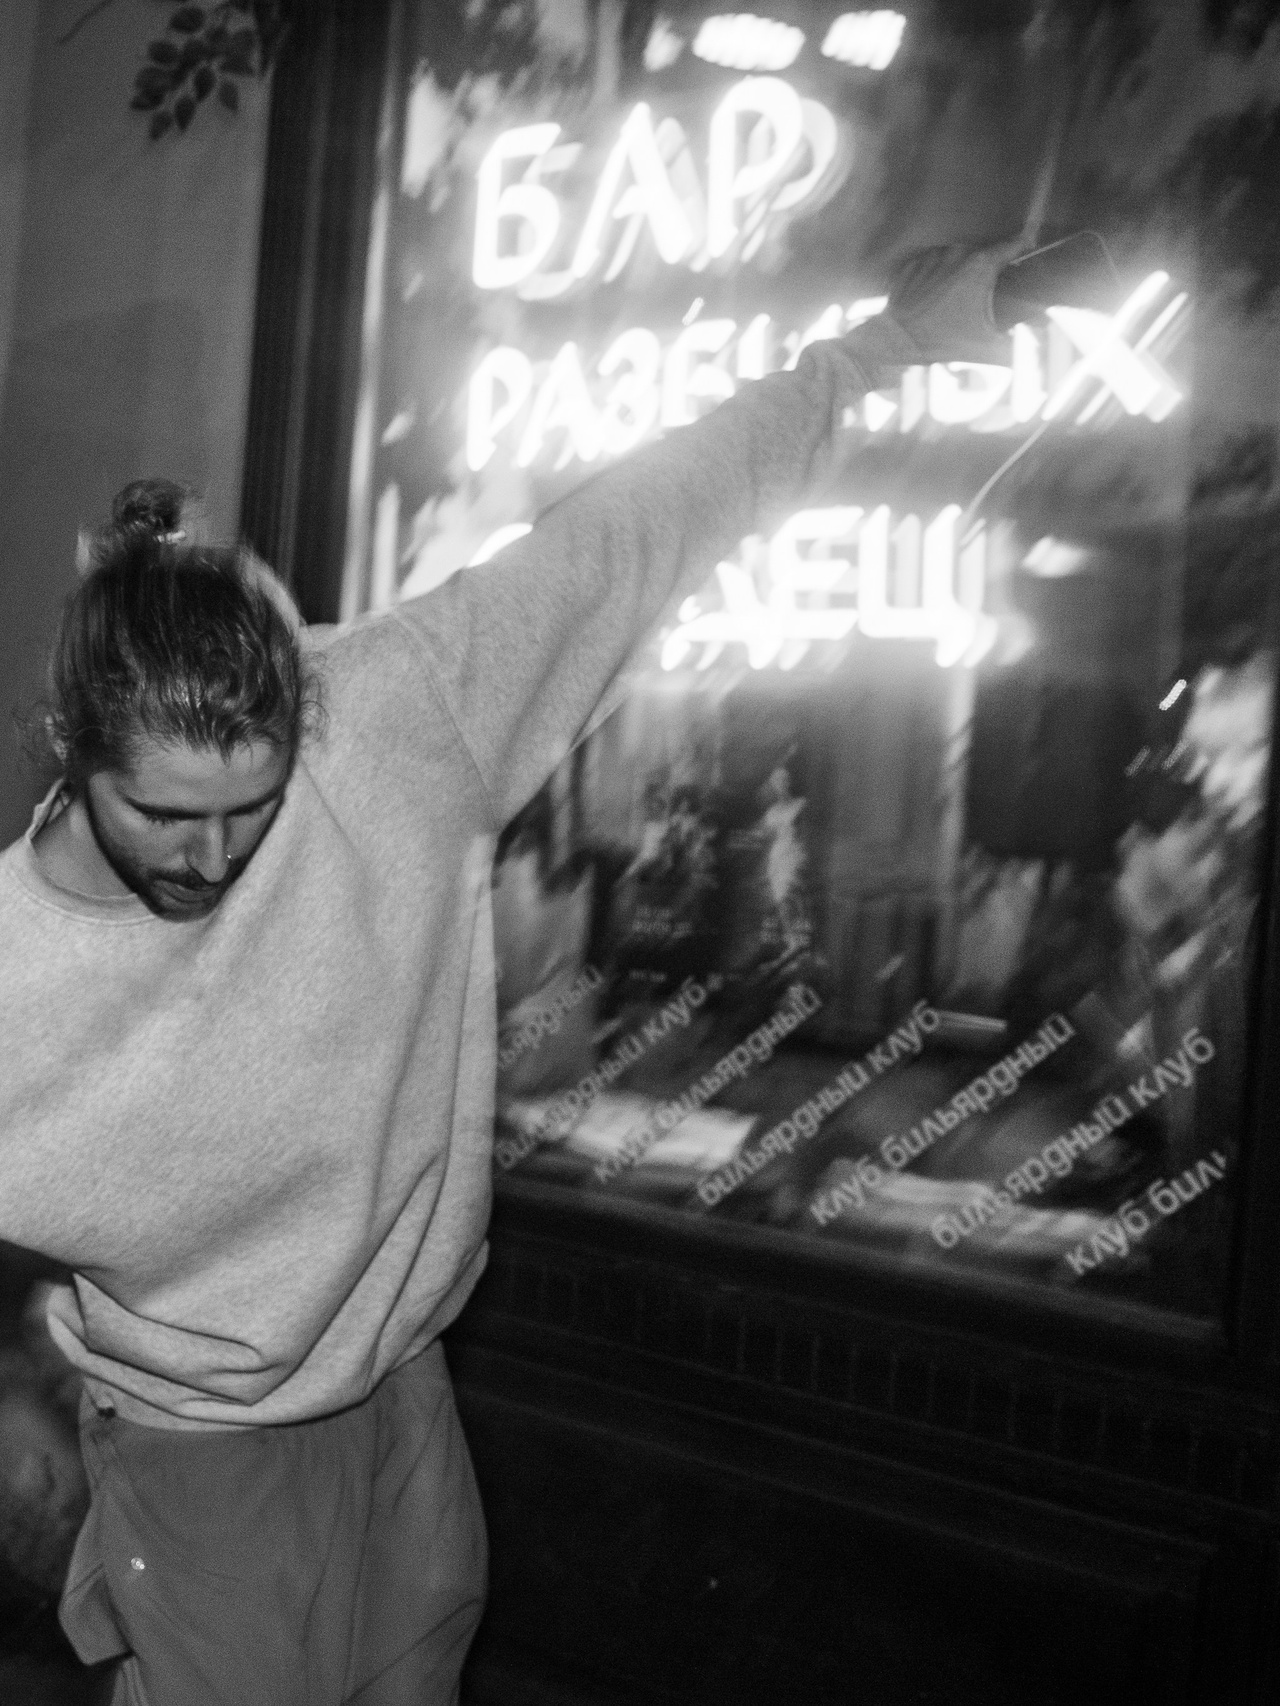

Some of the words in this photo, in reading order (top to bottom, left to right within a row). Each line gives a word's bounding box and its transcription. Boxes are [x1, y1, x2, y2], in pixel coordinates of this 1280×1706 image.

[472, 75, 830, 294] БАР
[641, 975, 708, 1046] клуб
[1128, 1028, 1216, 1107] клуб
[697, 1060, 871, 1206] бильярдный
[866, 999, 942, 1075] клуб
[810, 1154, 883, 1226] клуб
[878, 1012, 1077, 1170] бильярдный
[1066, 1200, 1150, 1276] клуб
